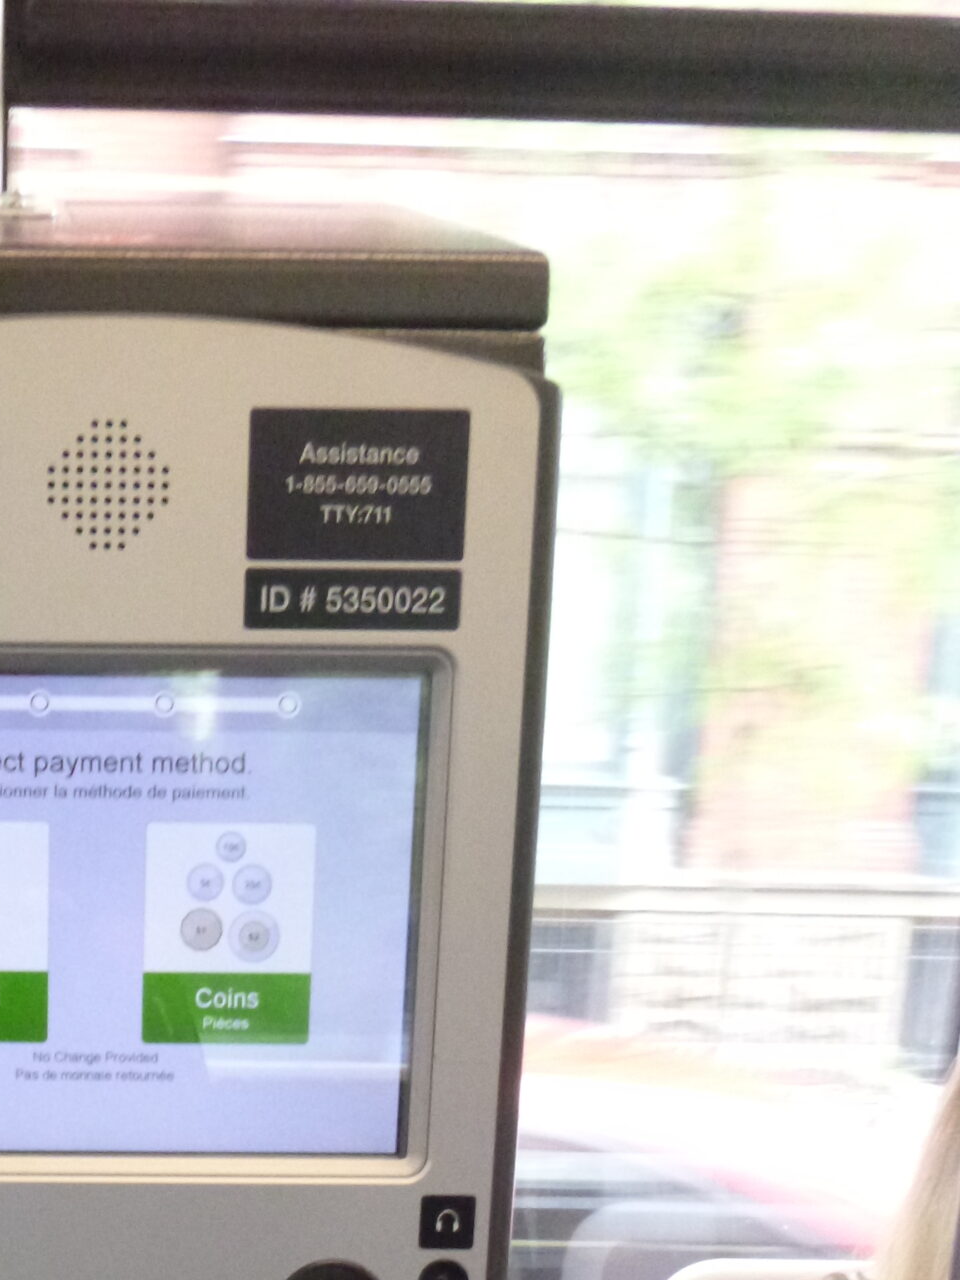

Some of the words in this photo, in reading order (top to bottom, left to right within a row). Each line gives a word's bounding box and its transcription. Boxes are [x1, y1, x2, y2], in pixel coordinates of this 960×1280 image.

[299, 441, 421, 465] Assistance
[320, 503, 393, 525] TTY:711
[259, 584, 290, 614] ID
[300, 585, 317, 613] #
[325, 585, 447, 615] 5350022
[33, 751, 144, 779] payment
[53, 783, 68, 799] la
[147, 784, 167, 800] de
[194, 987, 260, 1010] Coins
[32, 1051, 51, 1063] No
[54, 1051, 102, 1066] Change
[105, 1050, 160, 1064] Provided
[15, 1069, 39, 1082] Pas
[42, 1069, 57, 1082] de
[60, 1069, 112, 1082] monnaie
